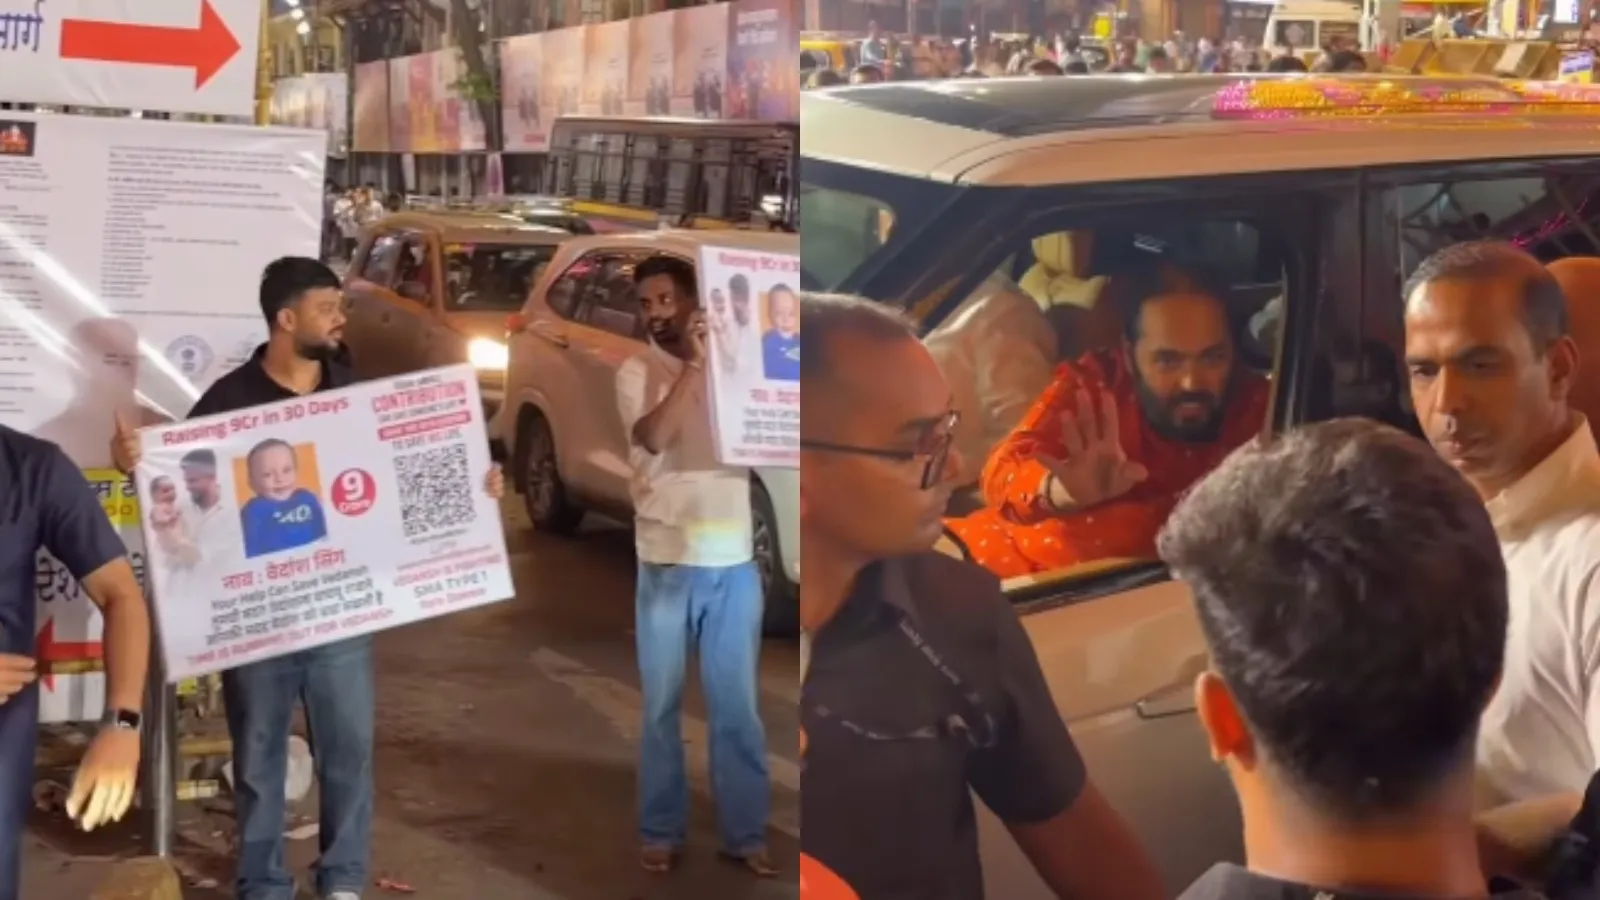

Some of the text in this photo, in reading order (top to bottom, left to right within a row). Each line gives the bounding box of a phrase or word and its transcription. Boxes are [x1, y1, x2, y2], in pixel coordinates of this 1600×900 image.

[372, 382, 466, 412] CONTRIBUTION
[162, 397, 349, 446] Raising 9Cr in 30 Days
[341, 470, 365, 501] 9
[414, 580, 443, 598] SMA
[446, 572, 479, 589] TYPE
